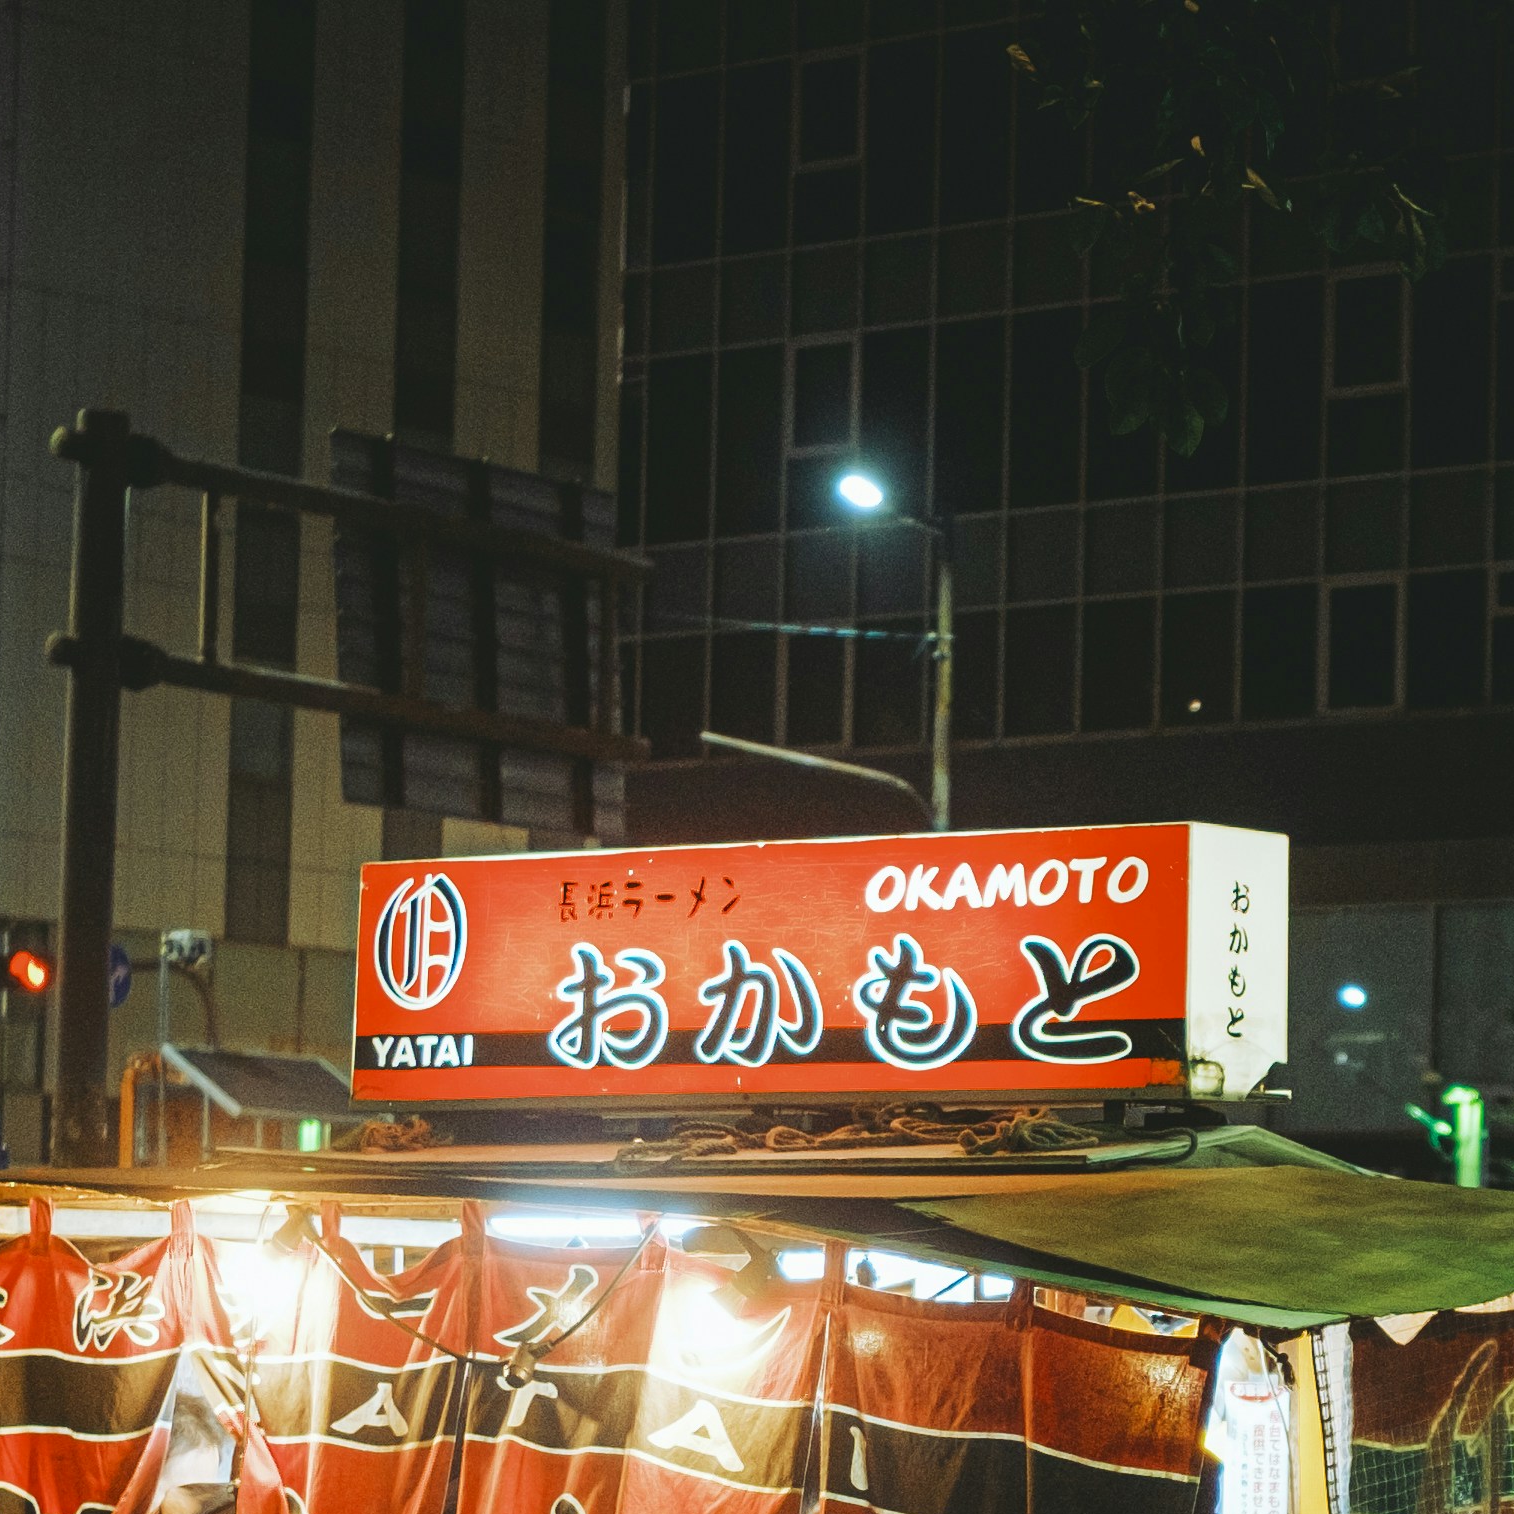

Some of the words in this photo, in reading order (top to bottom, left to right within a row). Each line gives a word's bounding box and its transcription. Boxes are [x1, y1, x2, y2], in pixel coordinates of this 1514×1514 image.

[865, 856, 1149, 913] OKAMOTO
[548, 933, 1141, 1070] おかもと
[1226, 879, 1250, 1038] おかもと
[372, 1034, 474, 1068] YATAI
